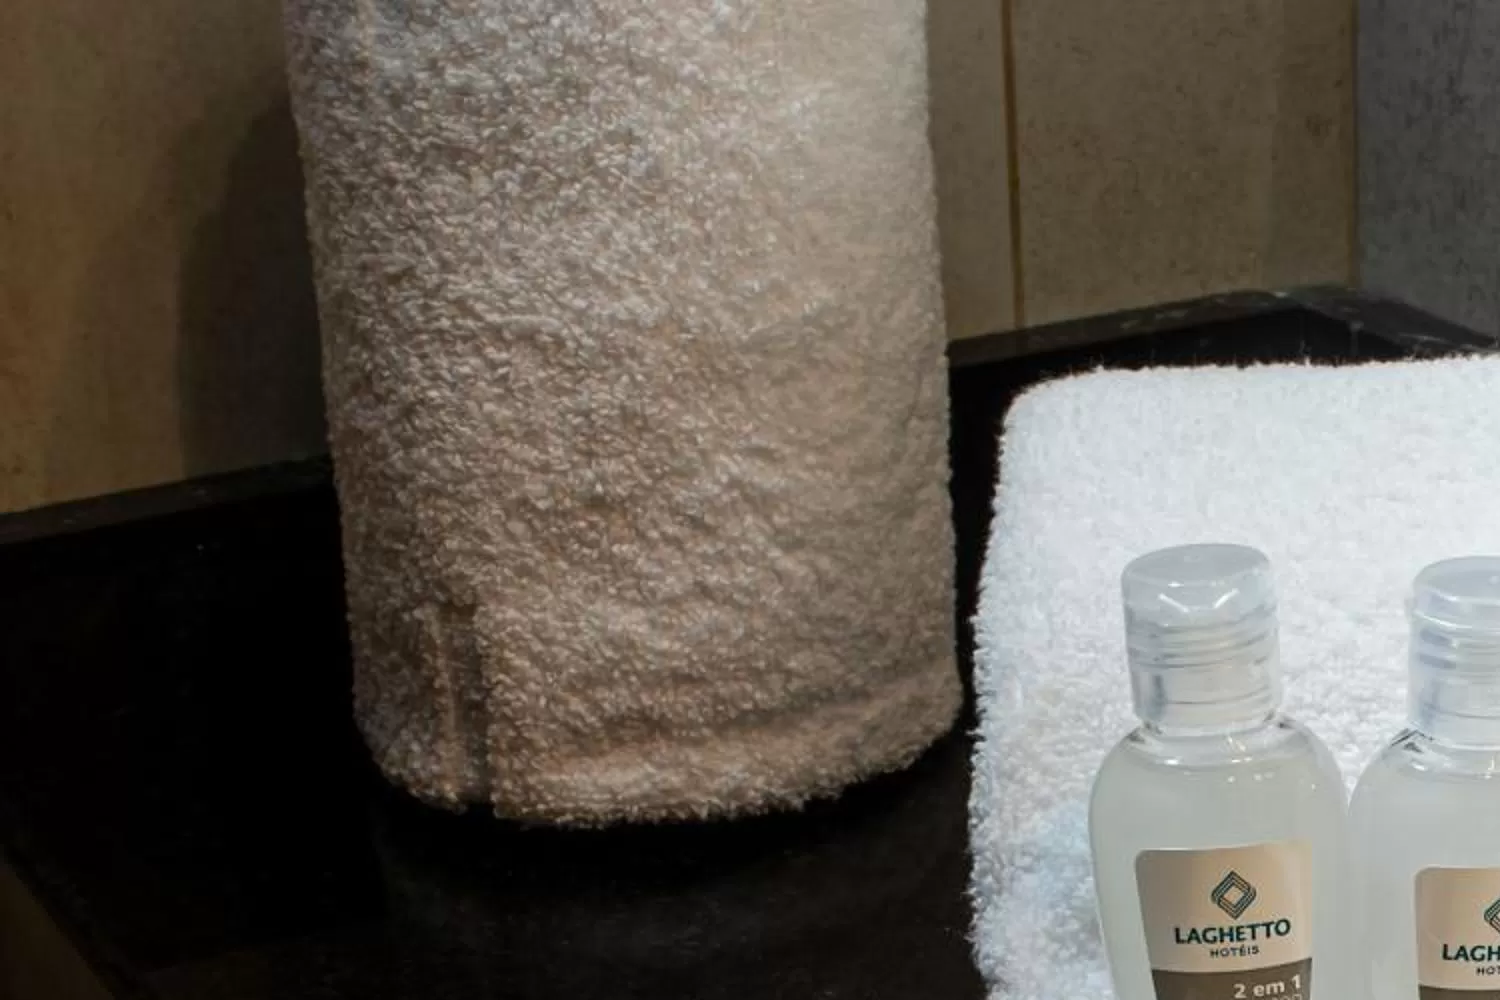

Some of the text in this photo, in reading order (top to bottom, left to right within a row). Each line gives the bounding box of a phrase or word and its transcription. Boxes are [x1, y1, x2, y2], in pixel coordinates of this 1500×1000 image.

[1174, 918, 1291, 945] LAGHETTO
[1209, 944, 1260, 959] HOTÉIS
[1233, 973, 1302, 999] 2 em 1
